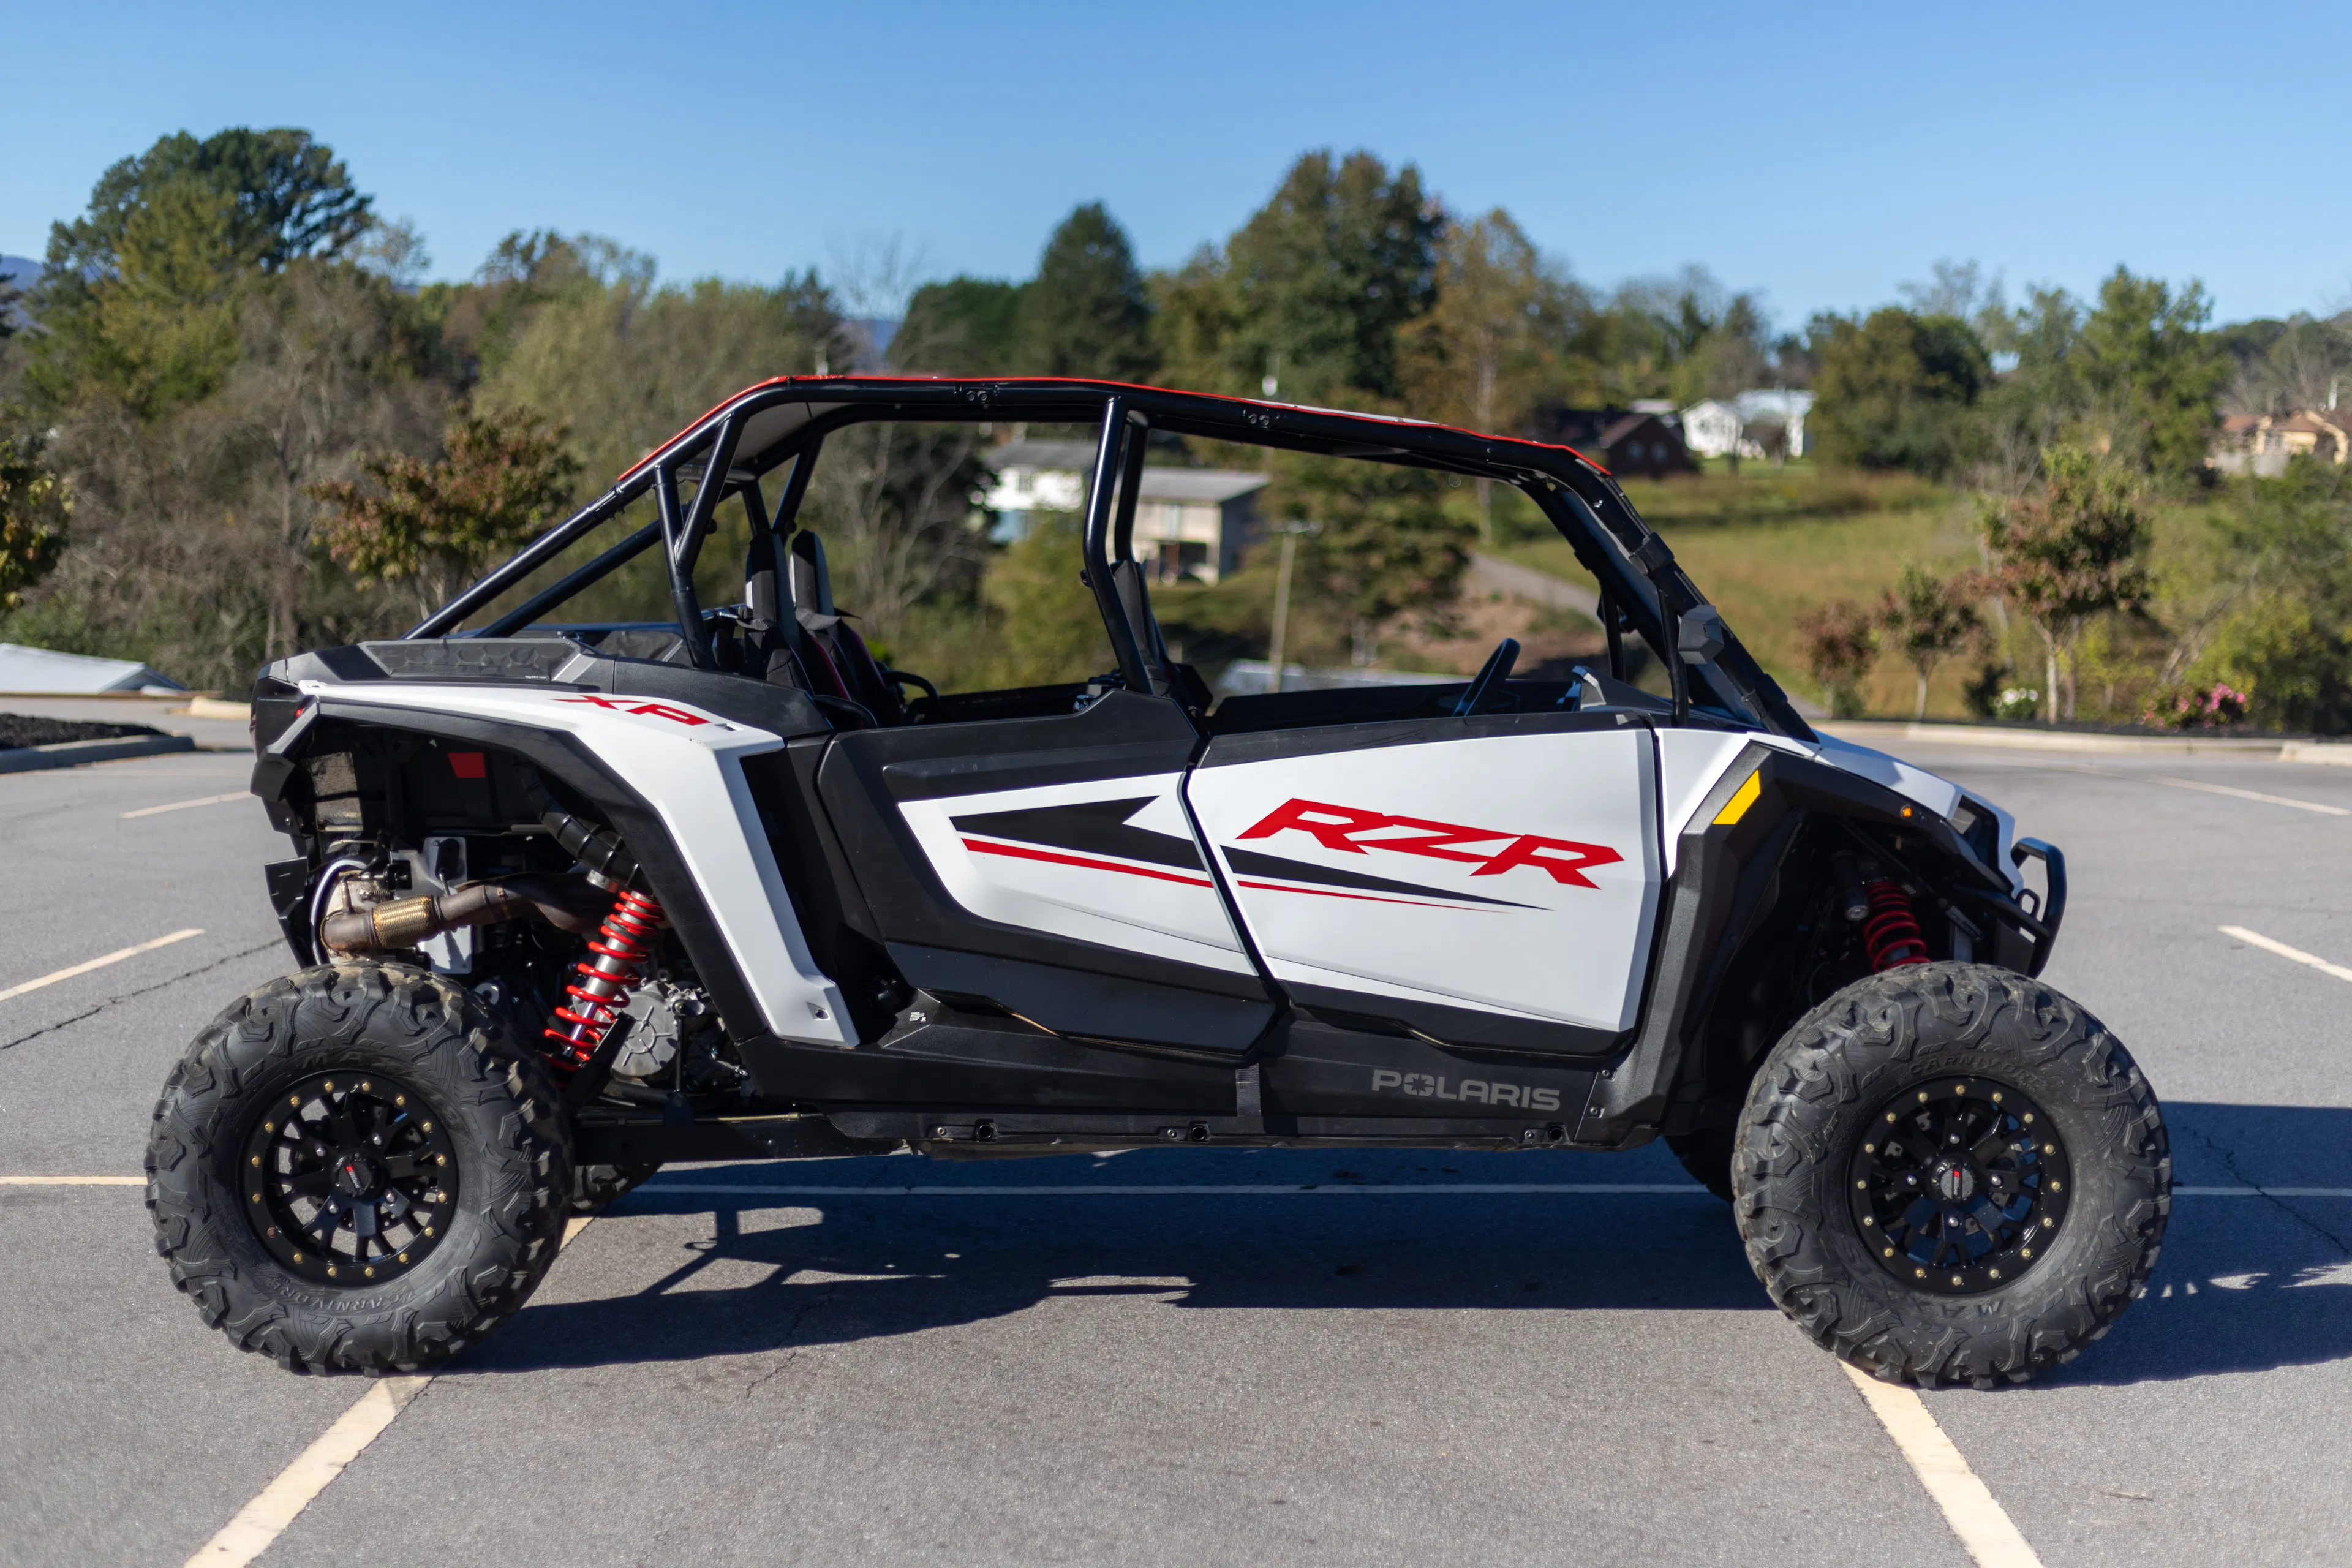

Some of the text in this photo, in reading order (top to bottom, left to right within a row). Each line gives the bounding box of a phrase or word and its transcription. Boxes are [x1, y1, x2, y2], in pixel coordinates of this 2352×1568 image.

[549, 695, 712, 726] XP
[1236, 798, 1624, 890] RZR
[1371, 1069, 1560, 1112] POLARIS
[268, 1278, 401, 1311] CARNIVORE
